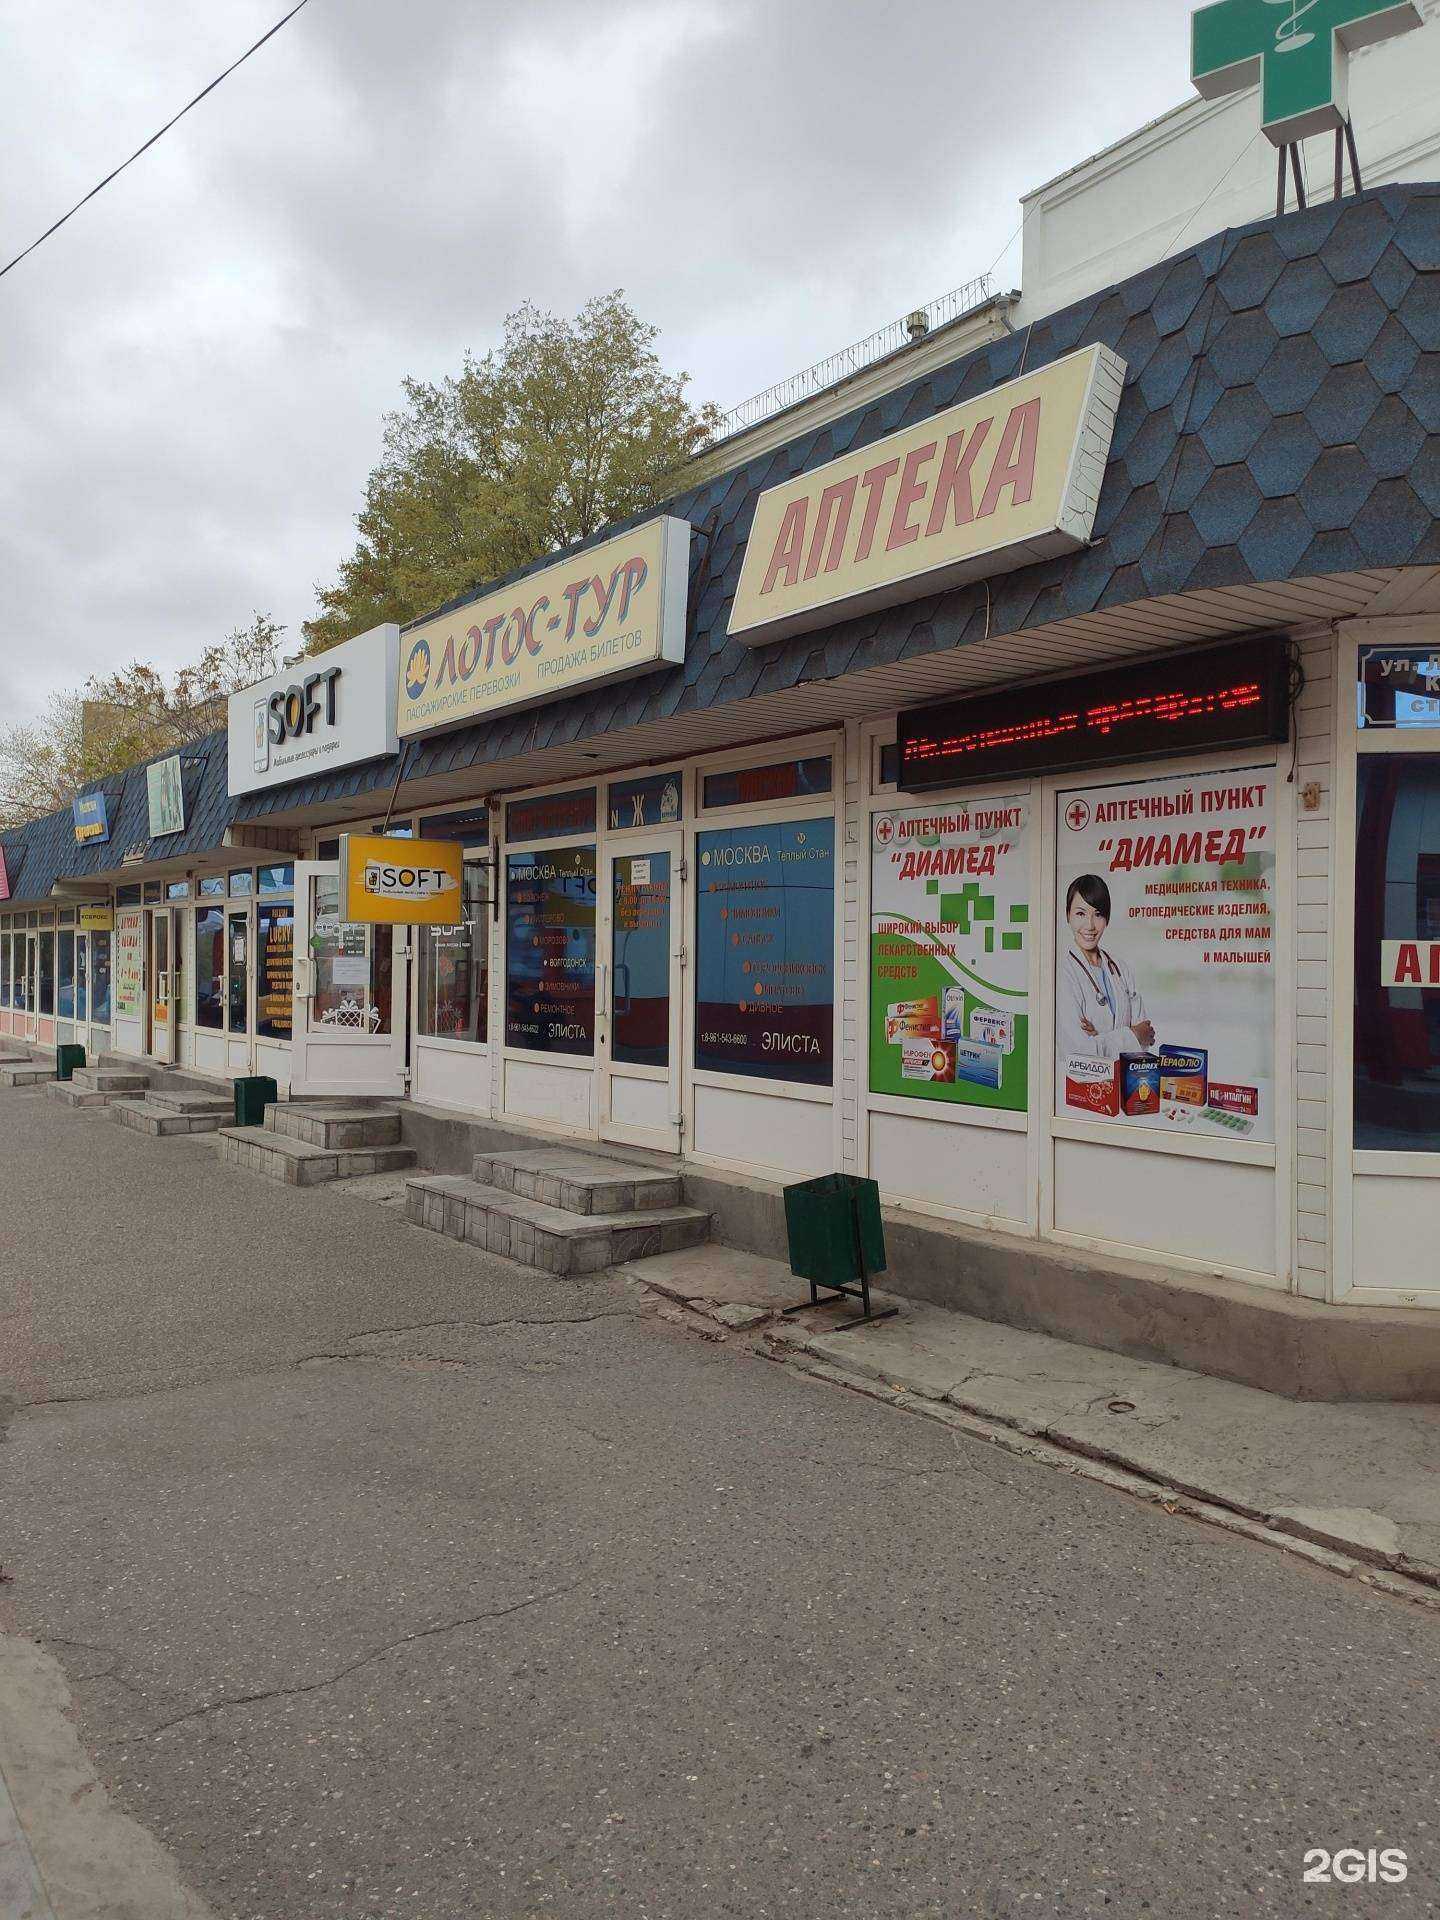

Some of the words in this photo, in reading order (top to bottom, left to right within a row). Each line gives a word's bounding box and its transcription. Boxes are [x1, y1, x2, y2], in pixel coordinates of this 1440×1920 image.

[760, 397, 1040, 594] АПТЕКА
[434, 557, 648, 689] ЛОТОС-ТУР
[406, 686, 468, 721] ПАССАЖИРСКИЕ
[469, 671, 522, 699] ПЕРЕВОЗКИ
[537, 649, 588, 680] ПРОДАЖА
[590, 629, 642, 665] БИЛЕТОВ
[267, 666, 342, 745] SOFT
[1095, 788, 1194, 823] АПТЕЧНЫЙ
[1200, 784, 1267, 812] ПУНКТ
[898, 810, 970, 838] АПТЕЧНЫЙ
[974, 808, 1022, 830] ПУНКТ
[714, 845, 771, 866] МОСКВА
[808, 847, 831, 860] Стан
[382, 868, 447, 888] SOFT
[518, 864, 556, 882] МОСКВА
[1145, 880, 1217, 896] МЕДИЦИНСКАЯ
[1128, 904, 1215, 919] ОРТОПЕДИЧЕСКИЕ
[1217, 903, 1271, 918] ИЗДЕЛИЯ,
[878, 920, 922, 935] ШИРОКИЙ
[925, 922, 959, 934] ВЫБОР
[1165, 928, 1217, 942] СРЕДСТВА
[1219, 928, 1242, 941] ДЛЯ
[1245, 927, 1271, 940] МАМ
[878, 944, 957, 957] ЛЕКАРСТВЕННЫХ
[1203, 952, 1210, 964] И
[1213, 949, 1271, 964] МАЛЫШЕЙ
[877, 966, 918, 979] СРЕДСТВ
[973, 1015, 1006, 1027] ФЕРВЕКС
[548, 1022, 586, 1039] ЭЛИСТА
[761, 1031, 822, 1054] ЭЛИСТА
[1069, 1060, 1111, 1075] АРБИДОЛ
[1160, 1055, 1201, 1068] ТЕРАФЛЮ
